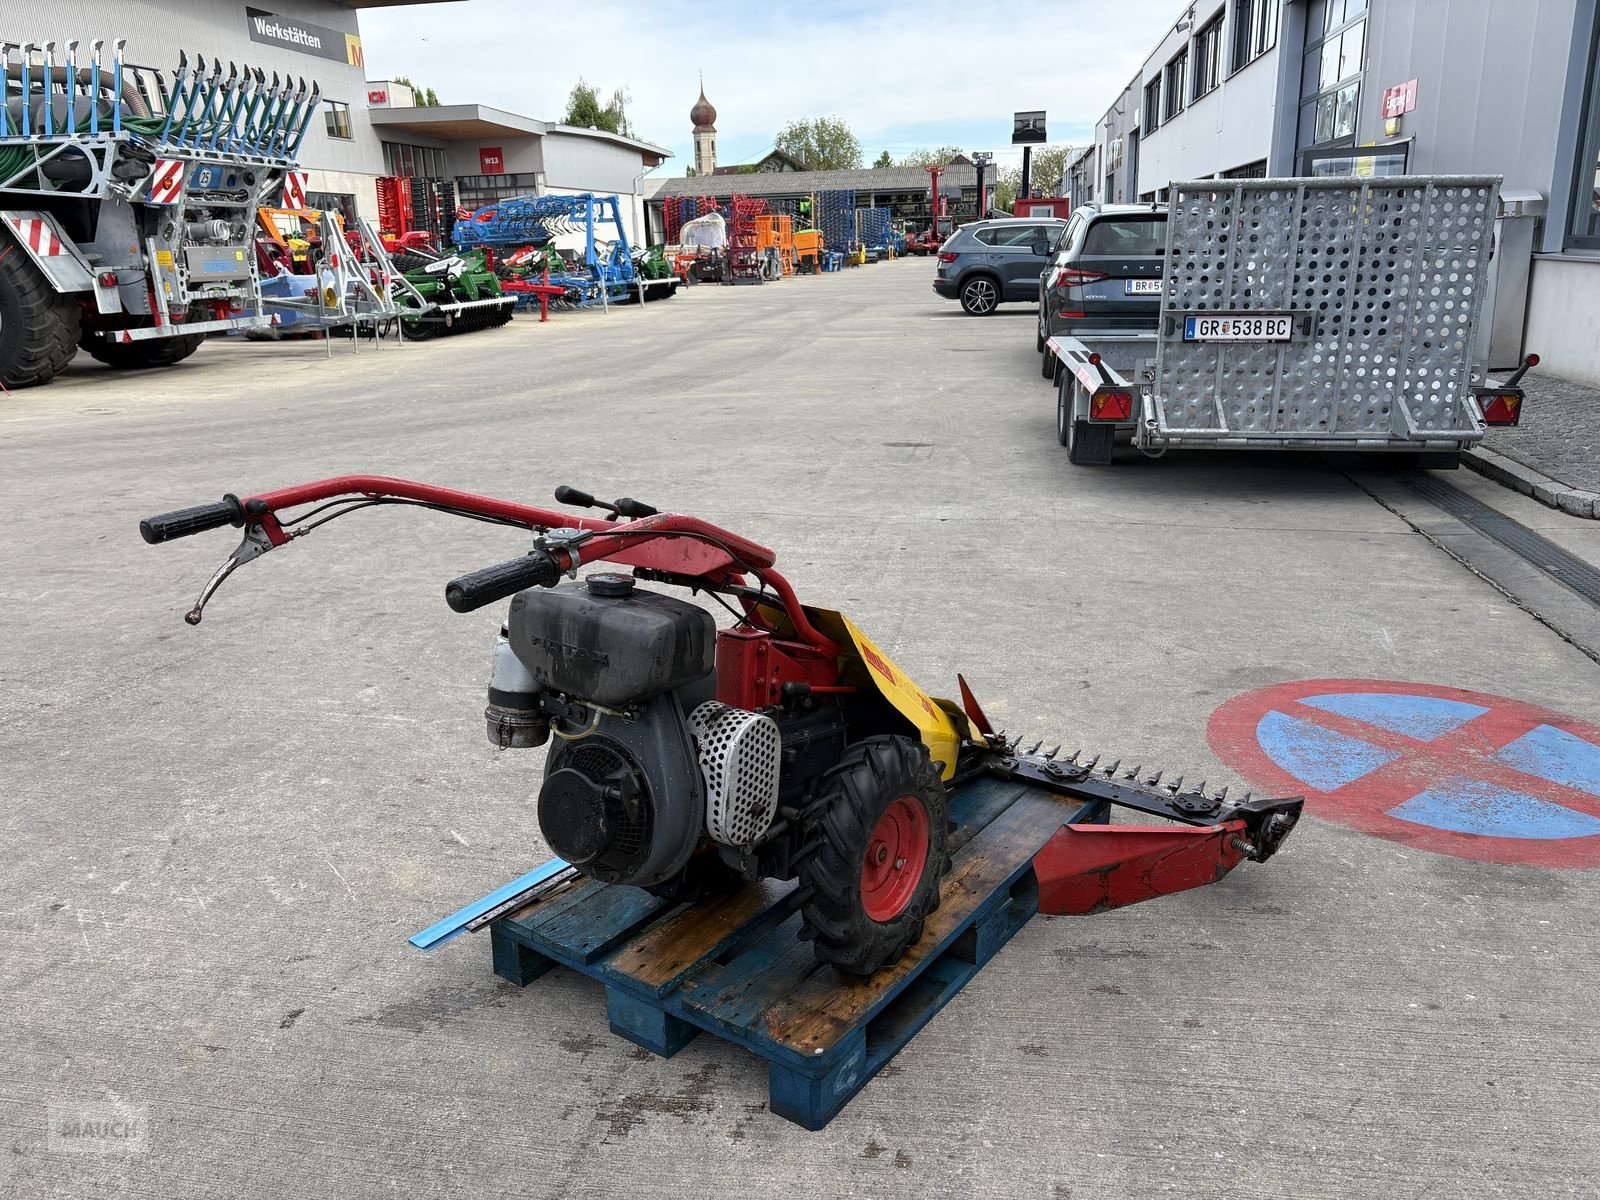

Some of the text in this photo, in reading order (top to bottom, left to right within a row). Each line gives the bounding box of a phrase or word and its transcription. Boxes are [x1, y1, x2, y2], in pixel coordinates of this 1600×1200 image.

[253, 17, 364, 69] Werkstätten M
[484, 157, 499, 165] W13
[201, 171, 210, 184] 25
[1135, 281, 1163, 291] BR 5
[1200, 319, 1286, 336] GR 538 BC
